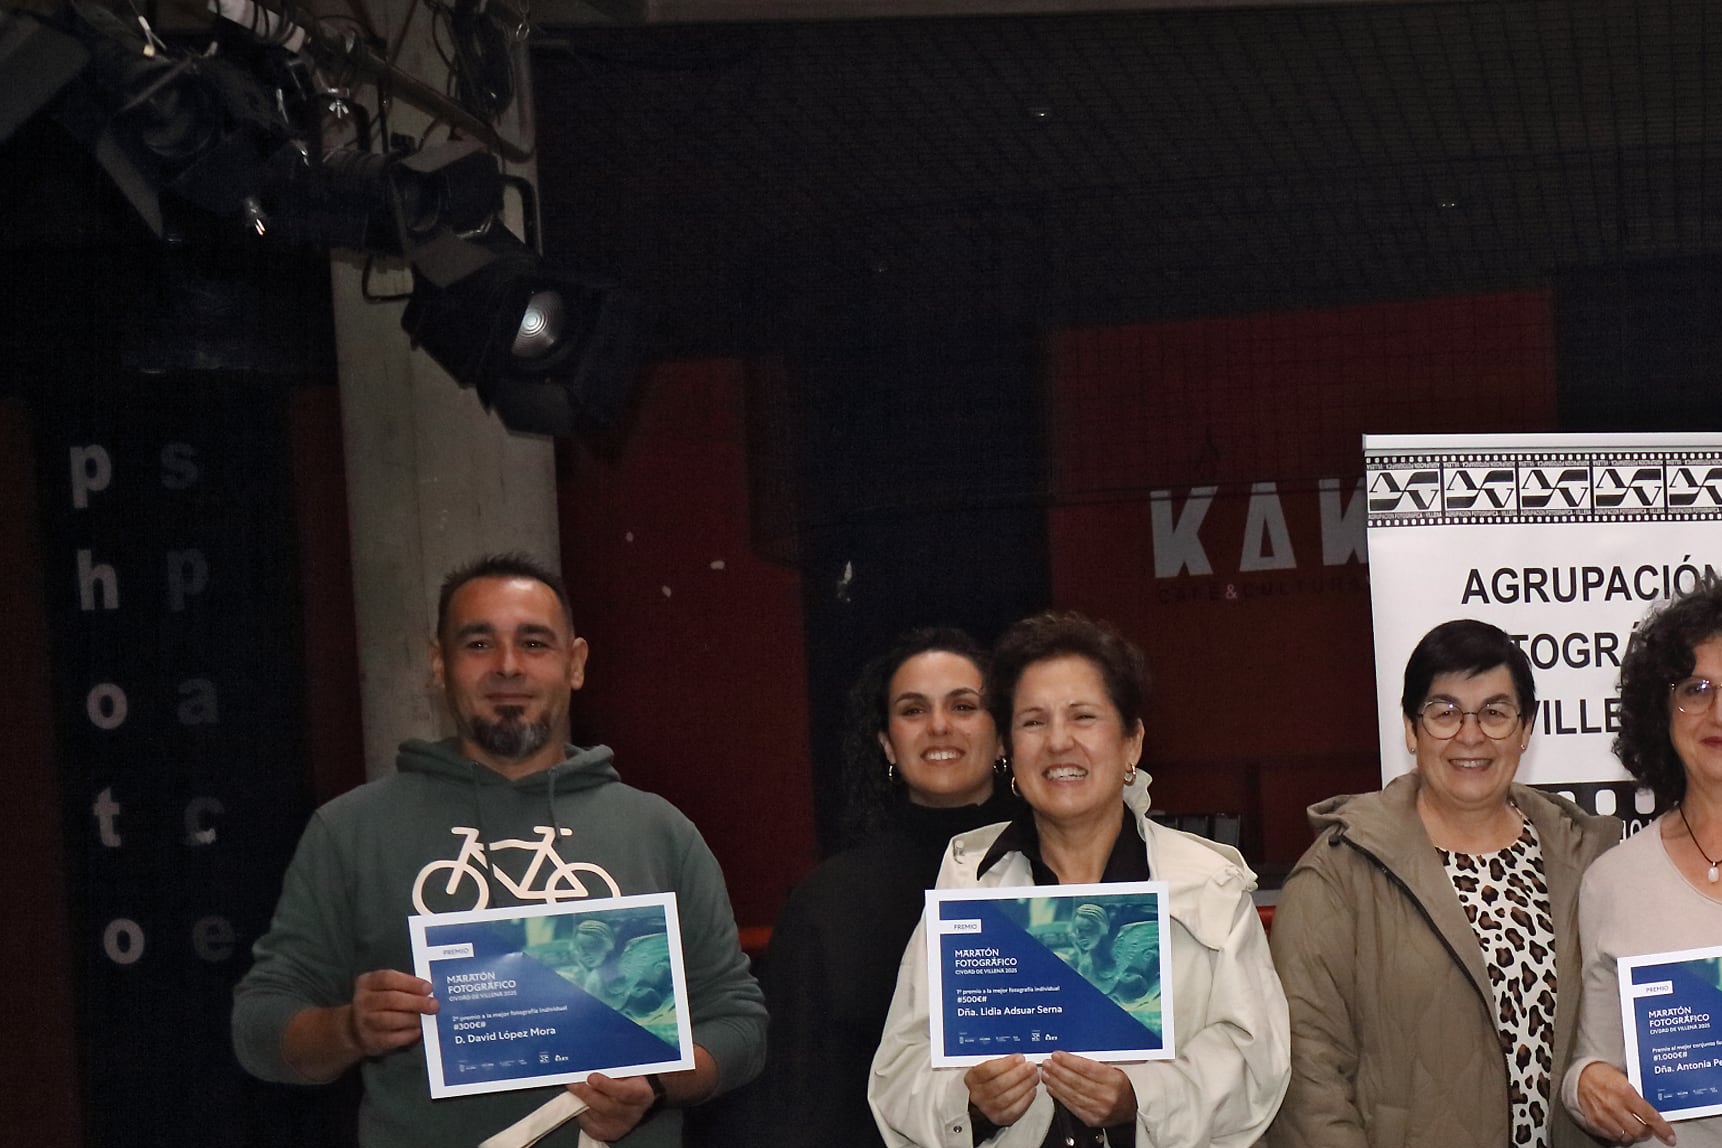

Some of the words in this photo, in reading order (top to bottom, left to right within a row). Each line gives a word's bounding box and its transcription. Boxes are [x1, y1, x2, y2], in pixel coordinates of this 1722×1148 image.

[955, 947, 999, 958] MARATÓN
[955, 957, 1018, 968] FOTOGRÁFICO
[447, 971, 496, 984] MARATÓN
[448, 980, 516, 994] FOTOGRÁFICO
[957, 1008, 978, 1016] Dña.
[981, 1007, 1002, 1016] Lidia
[1004, 1006, 1035, 1015] Adsuar
[1037, 1005, 1063, 1014] Serna
[1649, 1006, 1692, 1019] MARATÓN
[1649, 1013, 1710, 1028] FOTOGRÁFICO
[455, 1035, 465, 1044] D.
[468, 1032, 496, 1043] David
[498, 1030, 528, 1040] López
[530, 1027, 556, 1037] Mora
[1655, 1065, 1675, 1074] Dña.
[1677, 1060, 1711, 1071] Antonia
